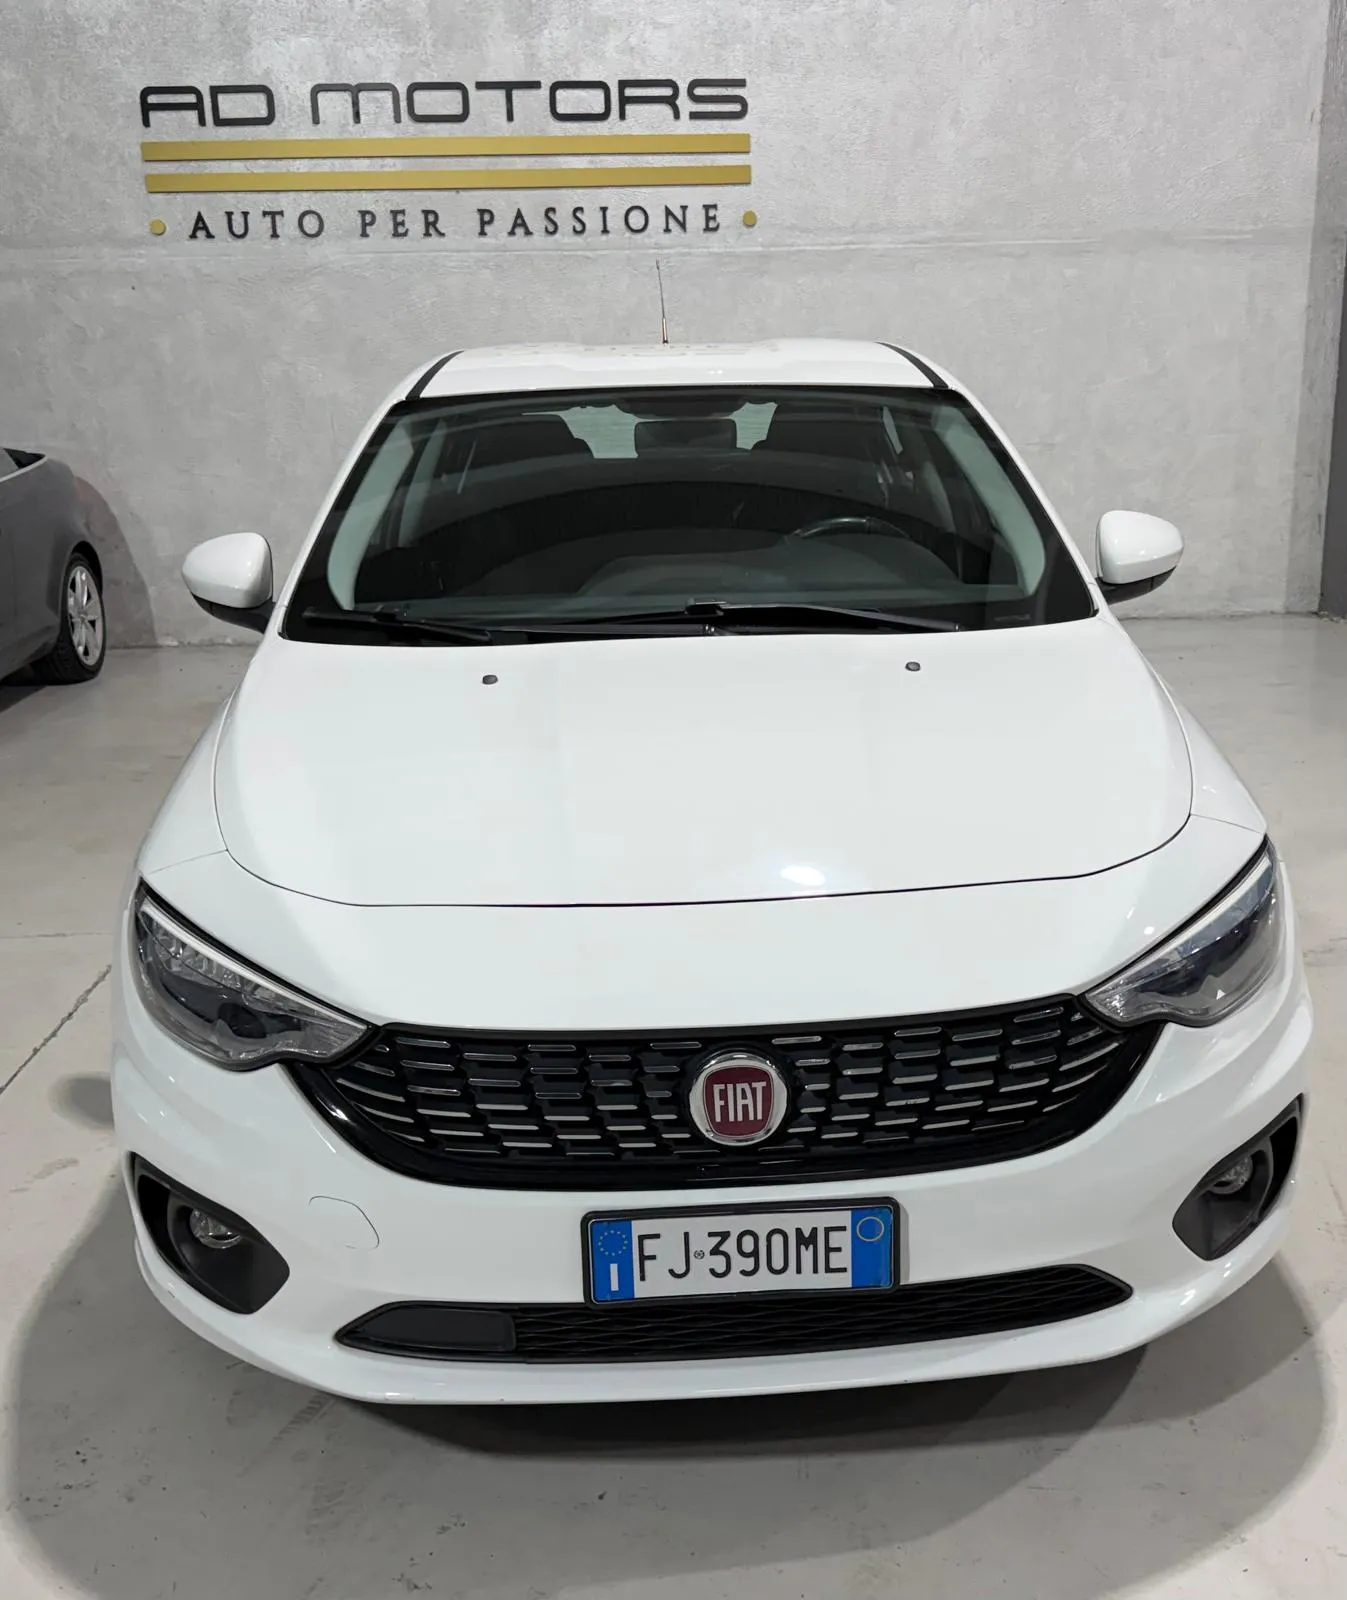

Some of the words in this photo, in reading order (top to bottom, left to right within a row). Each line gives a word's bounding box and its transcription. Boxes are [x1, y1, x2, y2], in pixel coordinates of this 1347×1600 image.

[139, 84, 276, 128] AD
[311, 78, 749, 125] MOTORS
[188, 209, 325, 240] AUTO
[360, 208, 446, 239] PER
[478, 204, 721, 237] PASSIONE
[712, 1081, 767, 1123] FIAT
